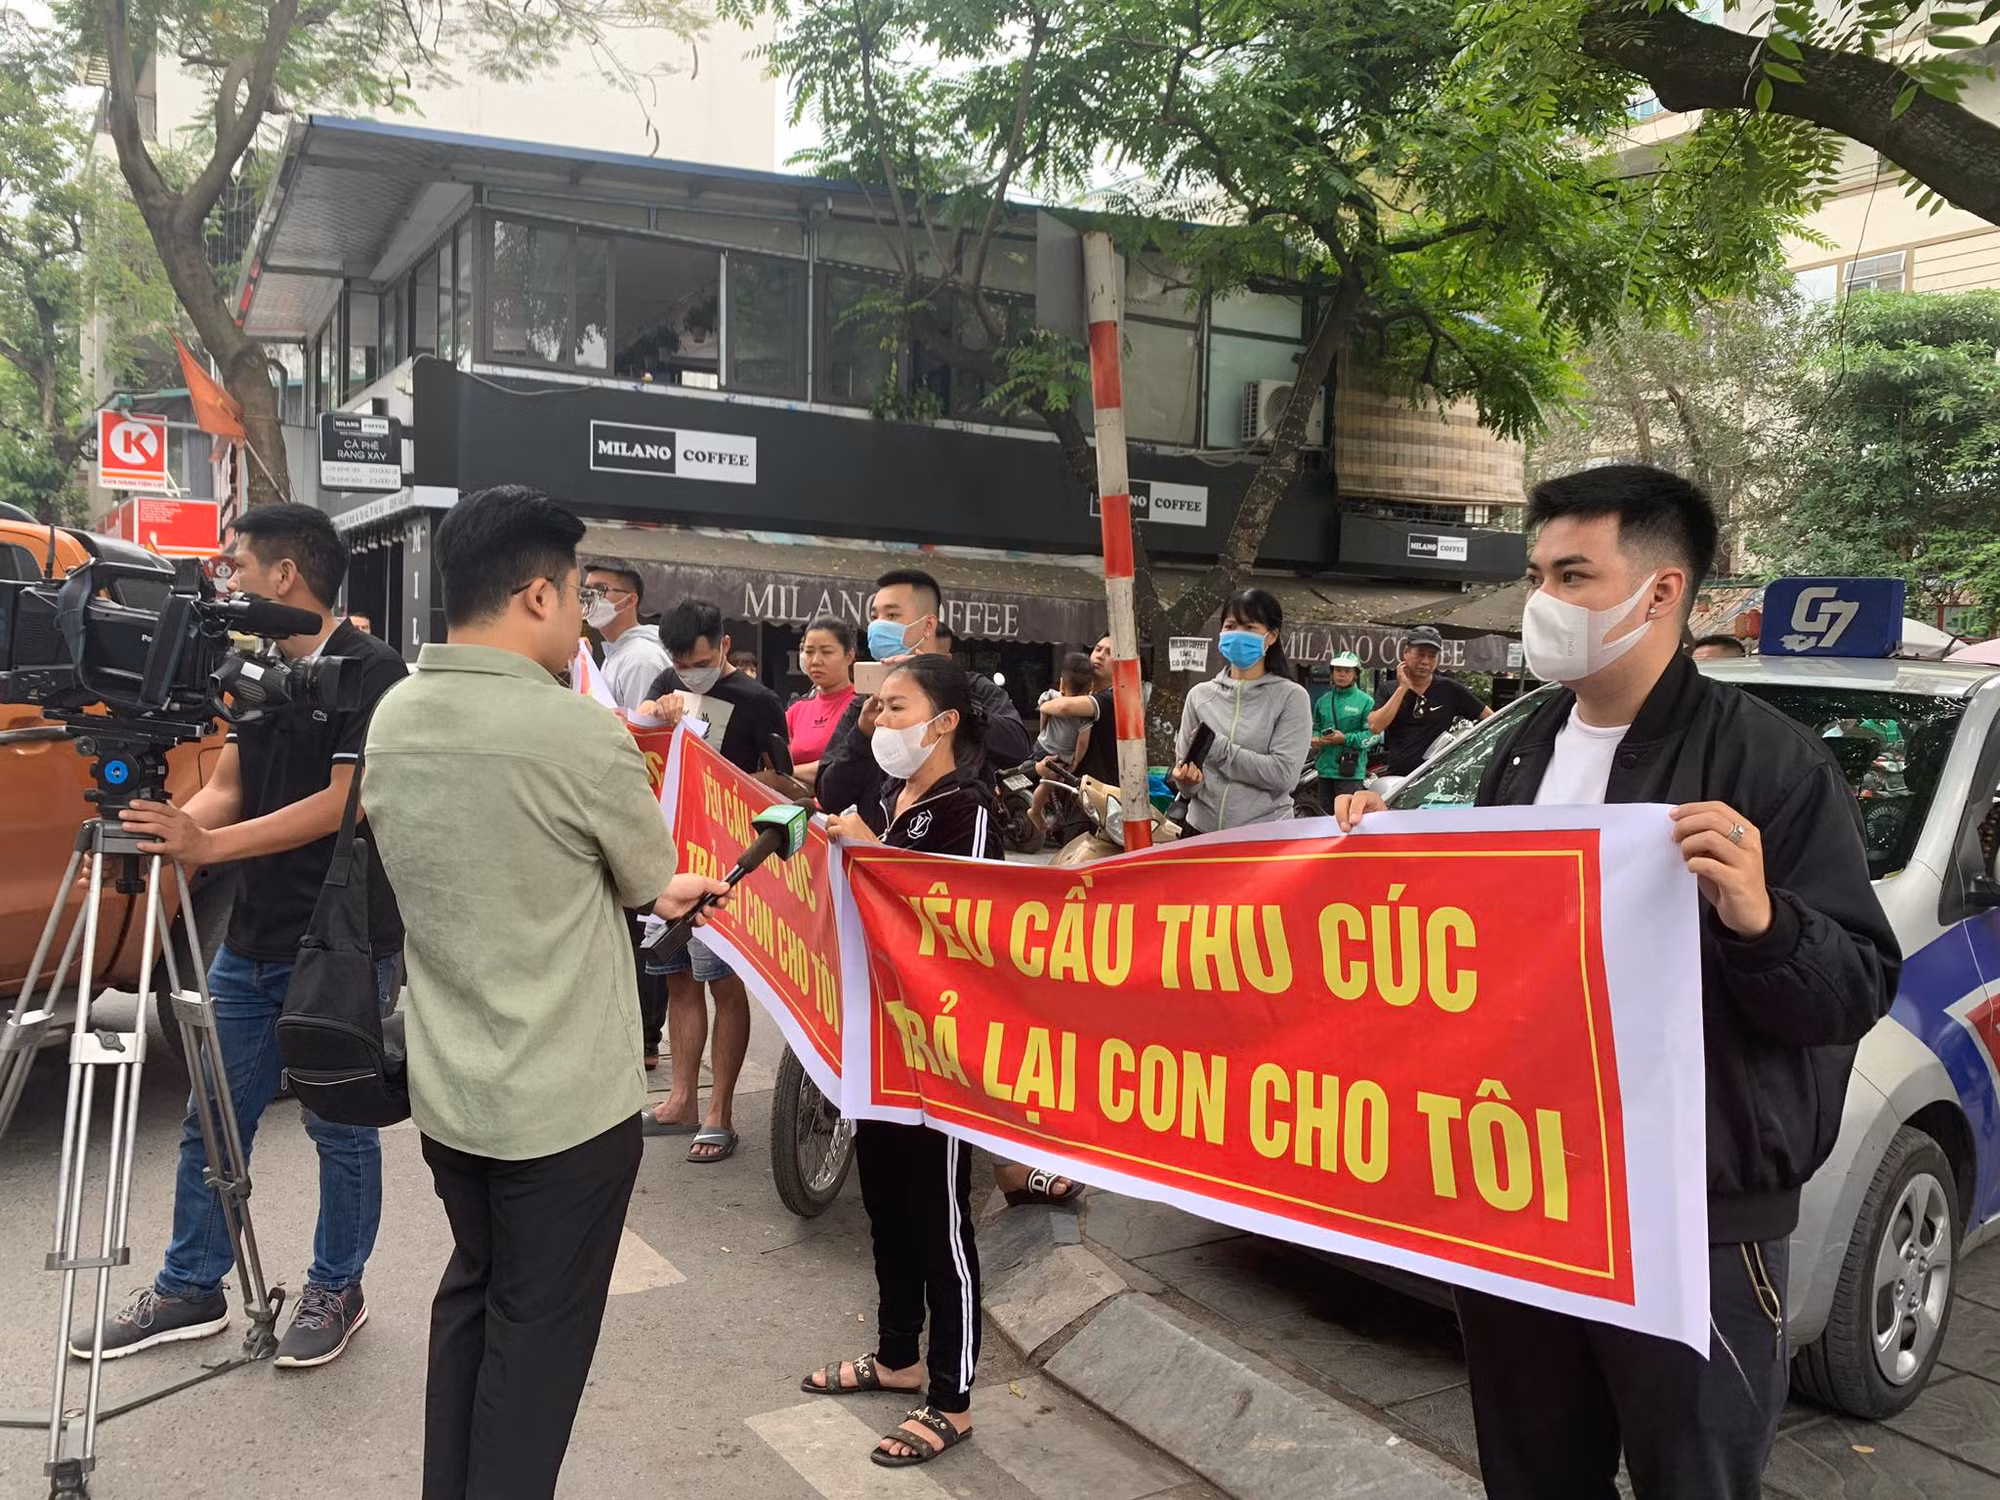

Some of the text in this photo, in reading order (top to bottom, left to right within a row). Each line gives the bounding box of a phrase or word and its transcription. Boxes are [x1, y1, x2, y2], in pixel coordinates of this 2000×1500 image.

[337, 449, 387, 462] RANG XAY
[361, 440, 380, 451] PHÊ
[598, 439, 750, 467] MILANO COFFEE
[1154, 497, 1203, 513] COFFEE
[1410, 542, 1465, 553] MILANO COFFEE
[741, 582, 1020, 637] MILAN FFEE
[1790, 586, 1861, 648] G7
[746, 886, 774, 959] CON
[777, 916, 809, 997] CHO
[811, 951, 840, 1036] TÔI
[900, 875, 1477, 1012] YÊU CẦU THU CÚC
[885, 990, 1570, 1222] TRẢ LẠI CON CHO TÔI
